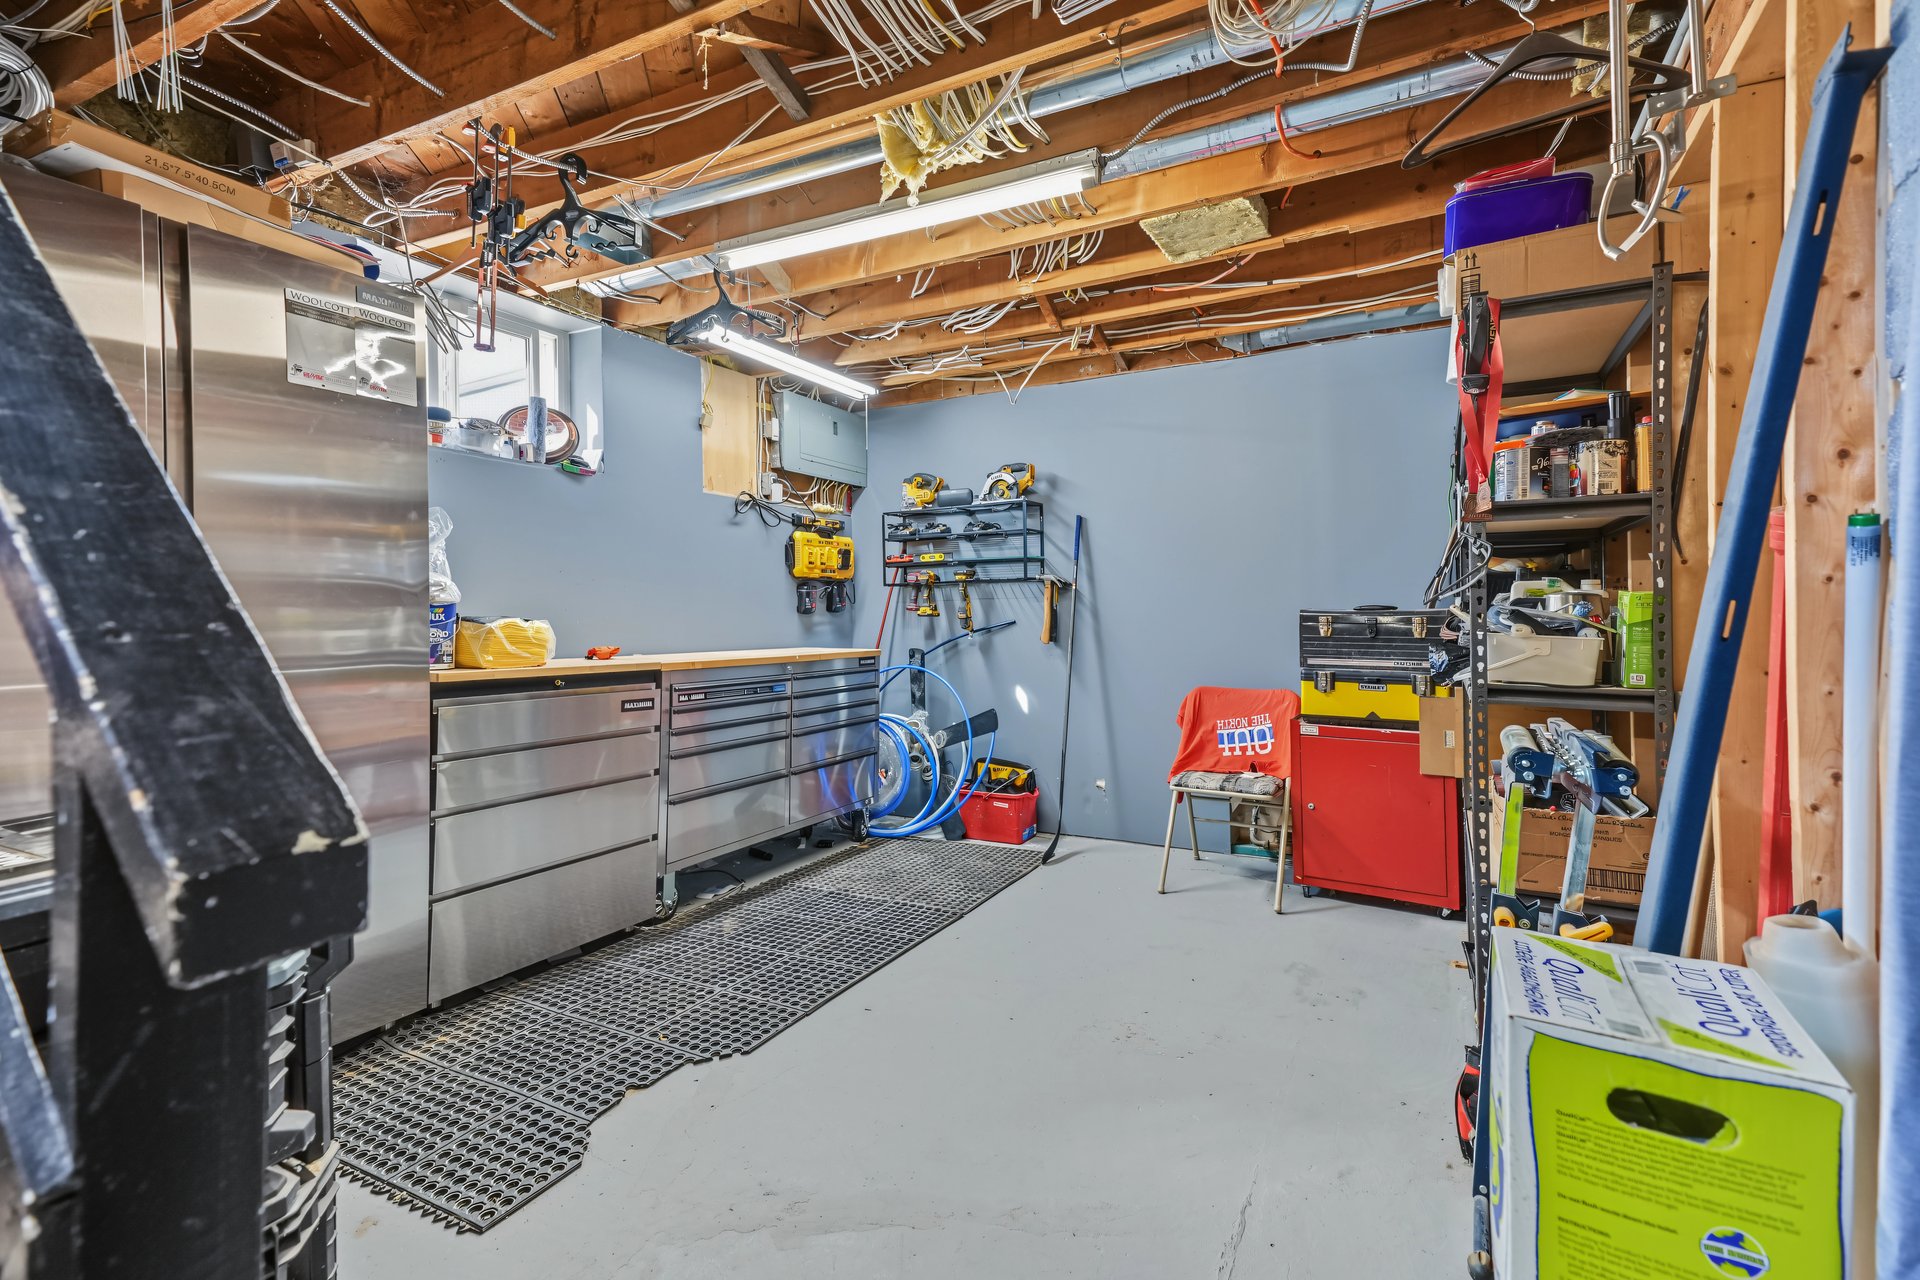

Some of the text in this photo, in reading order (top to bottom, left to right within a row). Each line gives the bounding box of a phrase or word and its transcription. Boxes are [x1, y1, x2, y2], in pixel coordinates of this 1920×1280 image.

[290, 290, 350, 315] WOOLCOTT
[362, 292, 409, 312] MAXIMUM
[359, 308, 412, 331] WOOLCOTT
[624, 701, 653, 709] MAXIMUM
[1216, 713, 1271, 730] THE NORTH
[1542, 958, 1602, 1025] QualiCat
[1671, 963, 1750, 1037] QualiCat
